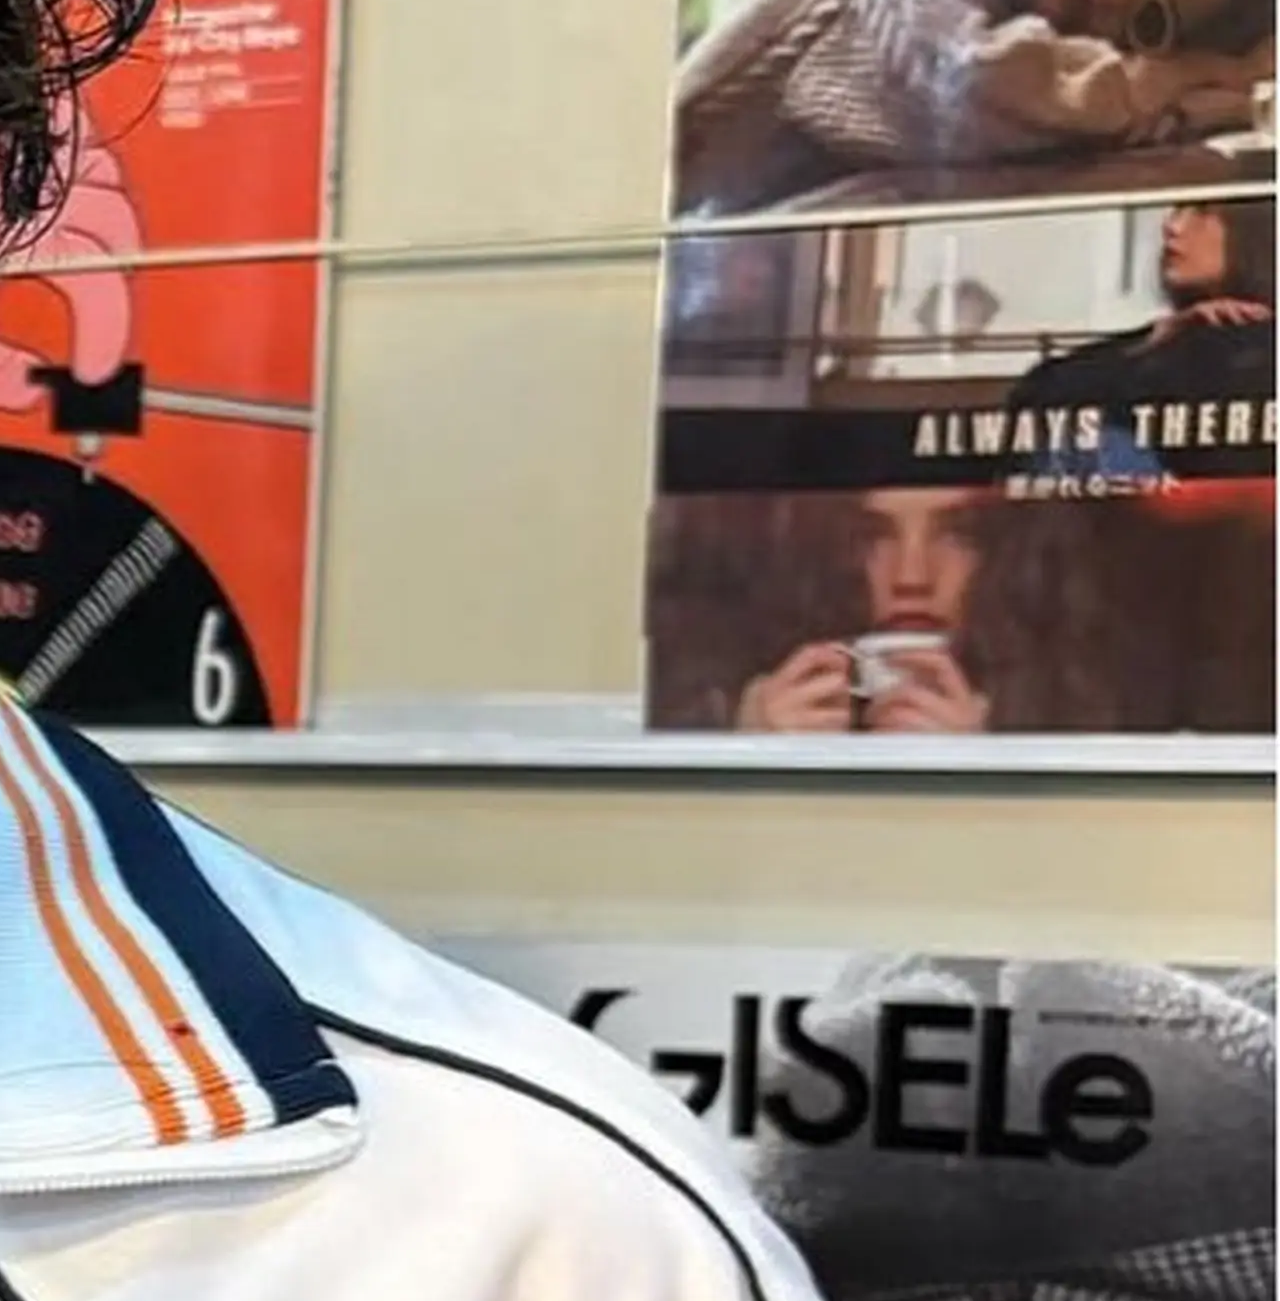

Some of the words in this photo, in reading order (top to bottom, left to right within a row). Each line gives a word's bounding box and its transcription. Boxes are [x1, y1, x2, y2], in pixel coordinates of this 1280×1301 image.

[914, 406, 1102, 457] ALWAYS
[1133, 399, 1276, 448] THERE
[192, 607, 237, 726] 6
